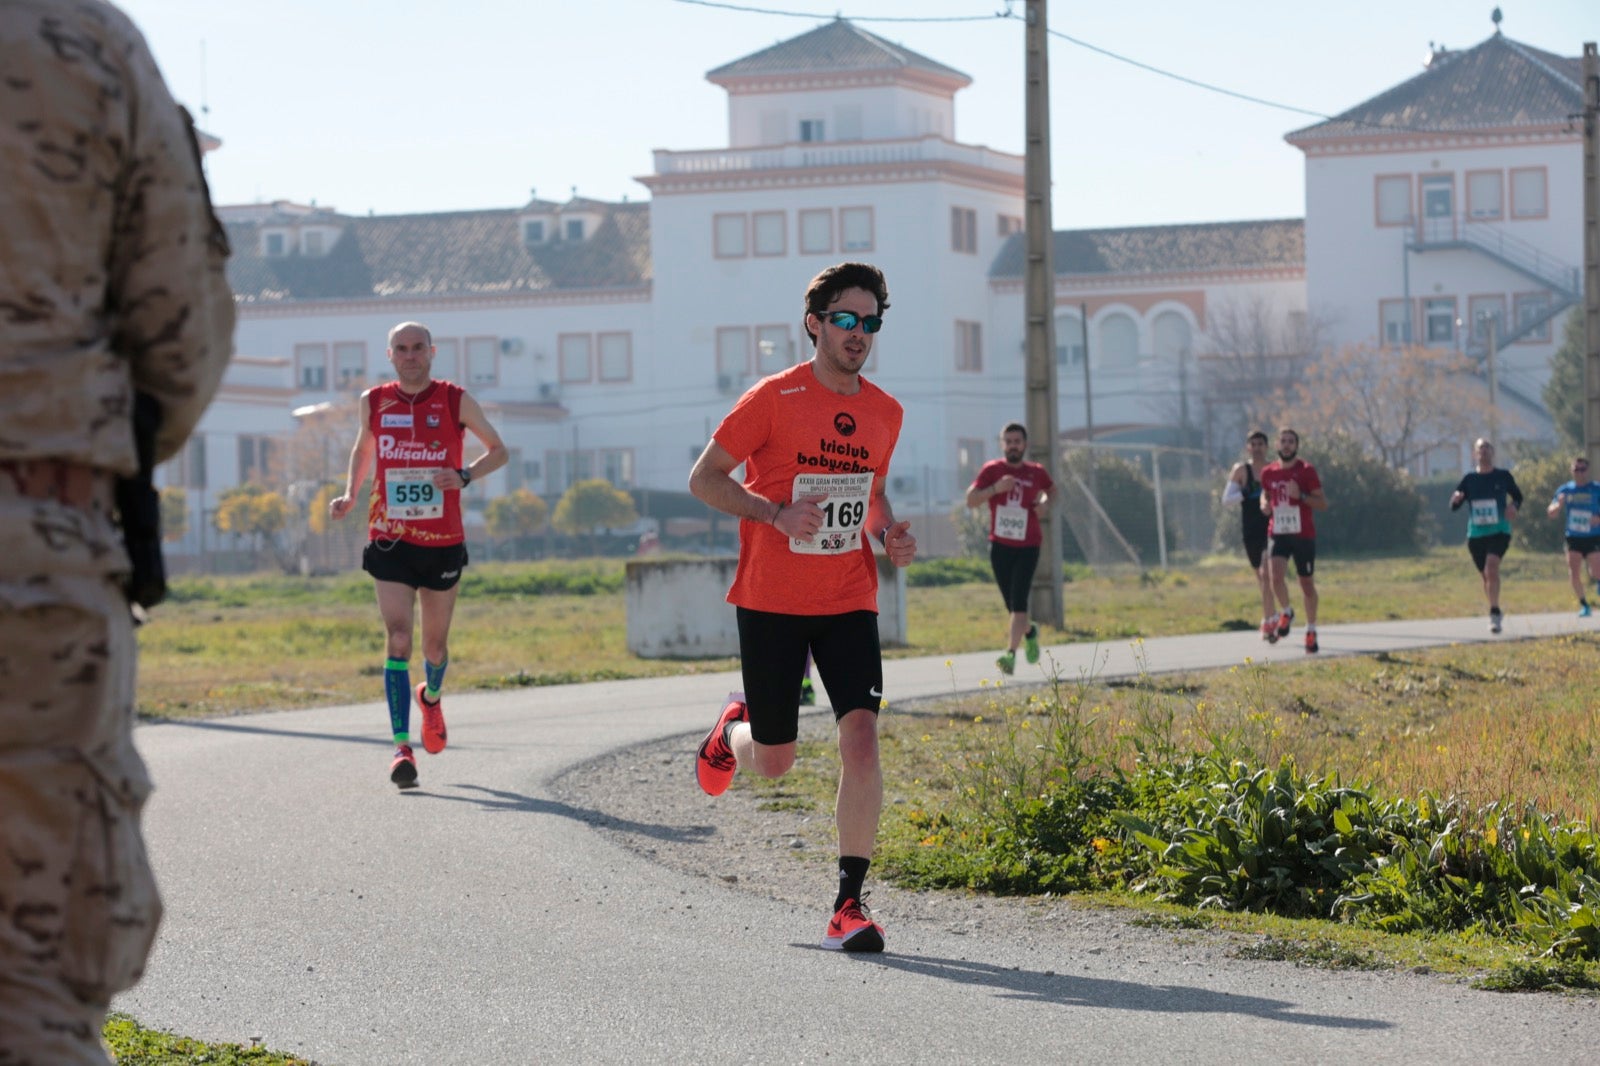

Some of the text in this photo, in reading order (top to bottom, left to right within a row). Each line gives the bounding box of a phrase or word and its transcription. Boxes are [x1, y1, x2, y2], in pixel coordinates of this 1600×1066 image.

[379, 434, 447, 460] Polisalud
[820, 438, 869, 460] triclub
[797, 452, 878, 474] babyscho
[831, 477, 849, 485] PREMIO
[849, 477, 857, 485] DE
[396, 484, 433, 503] 559
